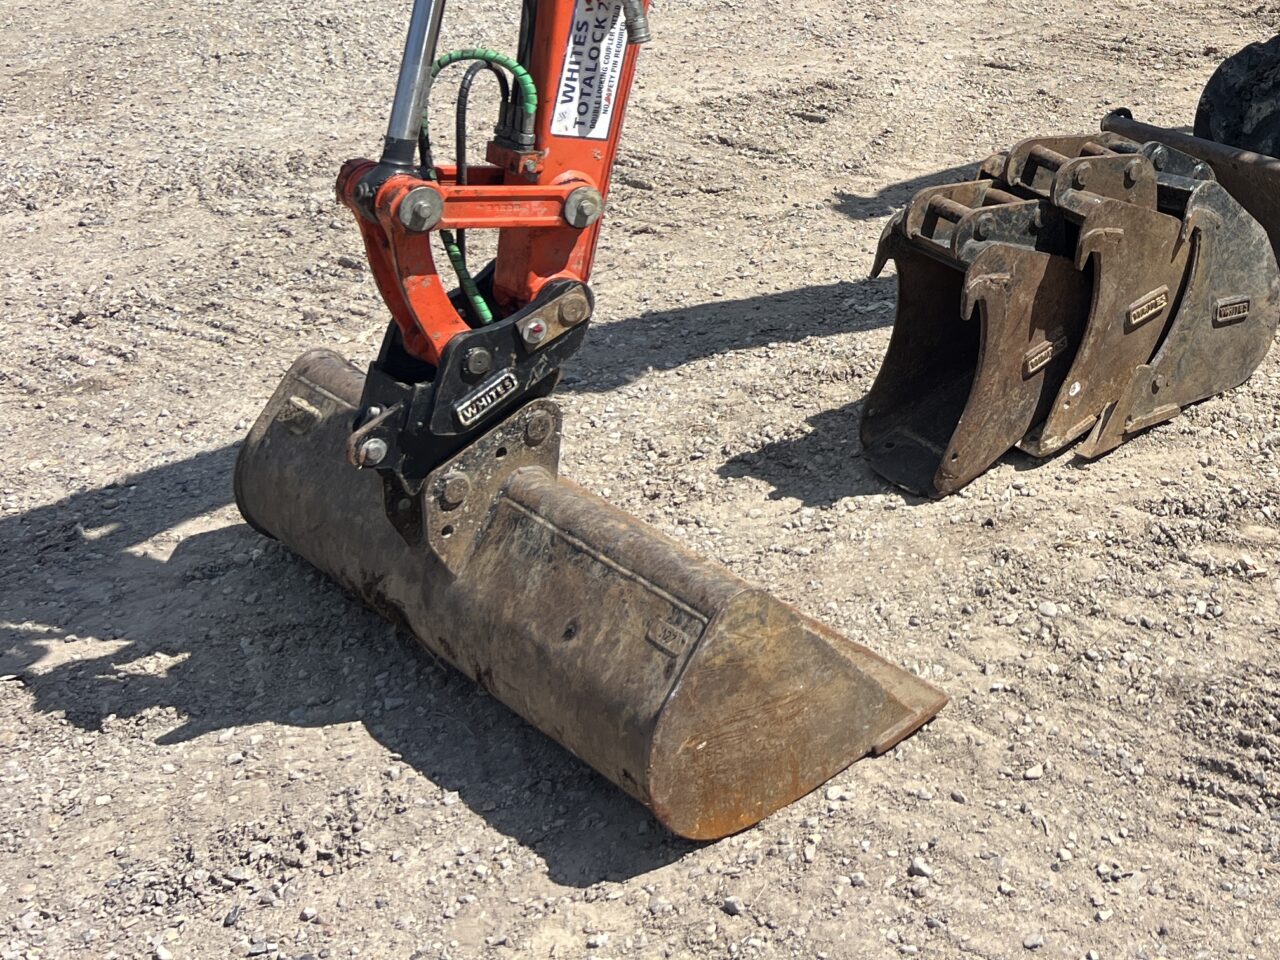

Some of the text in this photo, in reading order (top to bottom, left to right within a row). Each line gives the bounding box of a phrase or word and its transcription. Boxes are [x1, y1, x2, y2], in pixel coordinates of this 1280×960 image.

[560, 19, 590, 105] WHITES
[572, 16, 608, 129] TOTALOCK
[589, 100, 601, 129] DOUBLE
[595, 66, 608, 99] LOCKING
[602, 30, 615, 65] COUPLER
[602, 103, 610, 115] NO
[610, 59, 619, 73] PIN
[462, 378, 514, 419] WHITES
